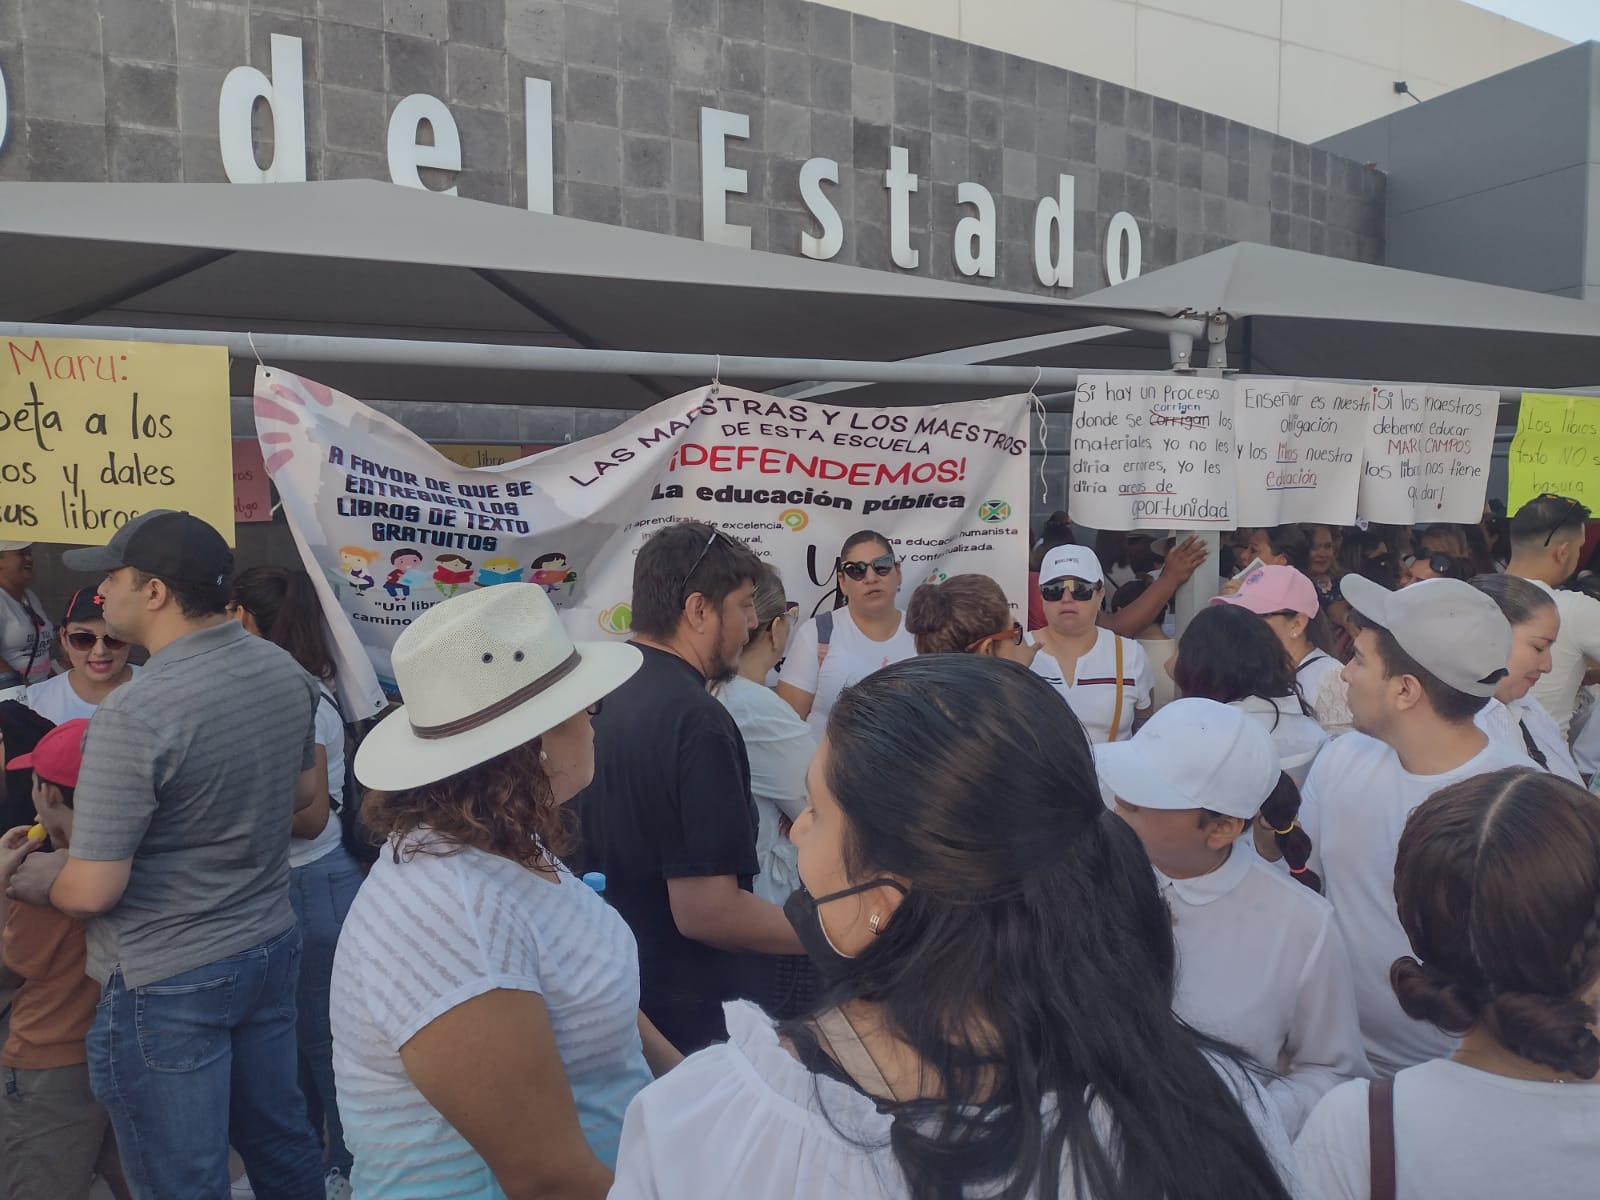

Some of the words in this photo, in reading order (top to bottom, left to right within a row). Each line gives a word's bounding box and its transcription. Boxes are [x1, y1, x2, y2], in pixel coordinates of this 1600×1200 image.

[219, 33, 553, 215] del
[701, 106, 1142, 287] Estado
[8, 340, 128, 383] Maru:
[1077, 383, 1096, 402] Si
[1106, 381, 1132, 401] hay
[1140, 385, 1156, 400] un
[1245, 389, 1303, 409] Enseñar
[1311, 395, 1326, 409] es
[1401, 388, 1419, 411] los
[85, 413, 107, 435] a
[131, 392, 173, 439] los
[1076, 411, 1118, 429] donde
[1219, 411, 1233, 430] los
[722, 422, 750, 437] DE
[760, 423, 825, 443] ESTA
[833, 433, 931, 455] ESCUELA
[1429, 420, 1470, 436] educar
[569, 448, 636, 487] LAS
[822, 409, 840, 426] Y
[850, 412, 908, 433] LOS
[915, 417, 1027, 456] MAESTROS
[1164, 438, 1180, 452] yo
[1189, 440, 1207, 451] no
[1216, 438, 1229, 453] les
[1237, 443, 1244, 460] y
[1249, 442, 1268, 460] los
[1306, 447, 1353, 463] nuestra
[1425, 438, 1472, 454] CAMPOS
[669, 443, 967, 486] ¡DEFENDEMOS!
[1204, 460, 1221, 474] les
[1559, 446, 1587, 467] NO
[0, 462, 37, 485] os
[63, 463, 78, 497] y
[101, 451, 175, 486] dales
[329, 445, 344, 466] A
[351, 453, 420, 487] FAVOR
[425, 477, 452, 493] DE
[458, 484, 500, 498] QUE
[506, 481, 534, 498] SE
[1365, 461, 1392, 479] los
[1425, 462, 1444, 476] nos
[1449, 458, 1481, 477] tiene
[1155, 479, 1173, 493] de
[1533, 472, 1584, 493] basura
[478, 501, 520, 516] LOS
[651, 483, 684, 500] La
[696, 485, 853, 511] educación
[862, 493, 966, 515] pública
[337, 498, 420, 523] LIBROS
[428, 507, 457, 527] DE
[464, 511, 530, 534] TEXTO
[722, 521, 784, 530] excelencia,
[372, 522, 498, 552] GRATUITOS
[411, 601, 442, 610] libr
[353, 612, 412, 626] camino
